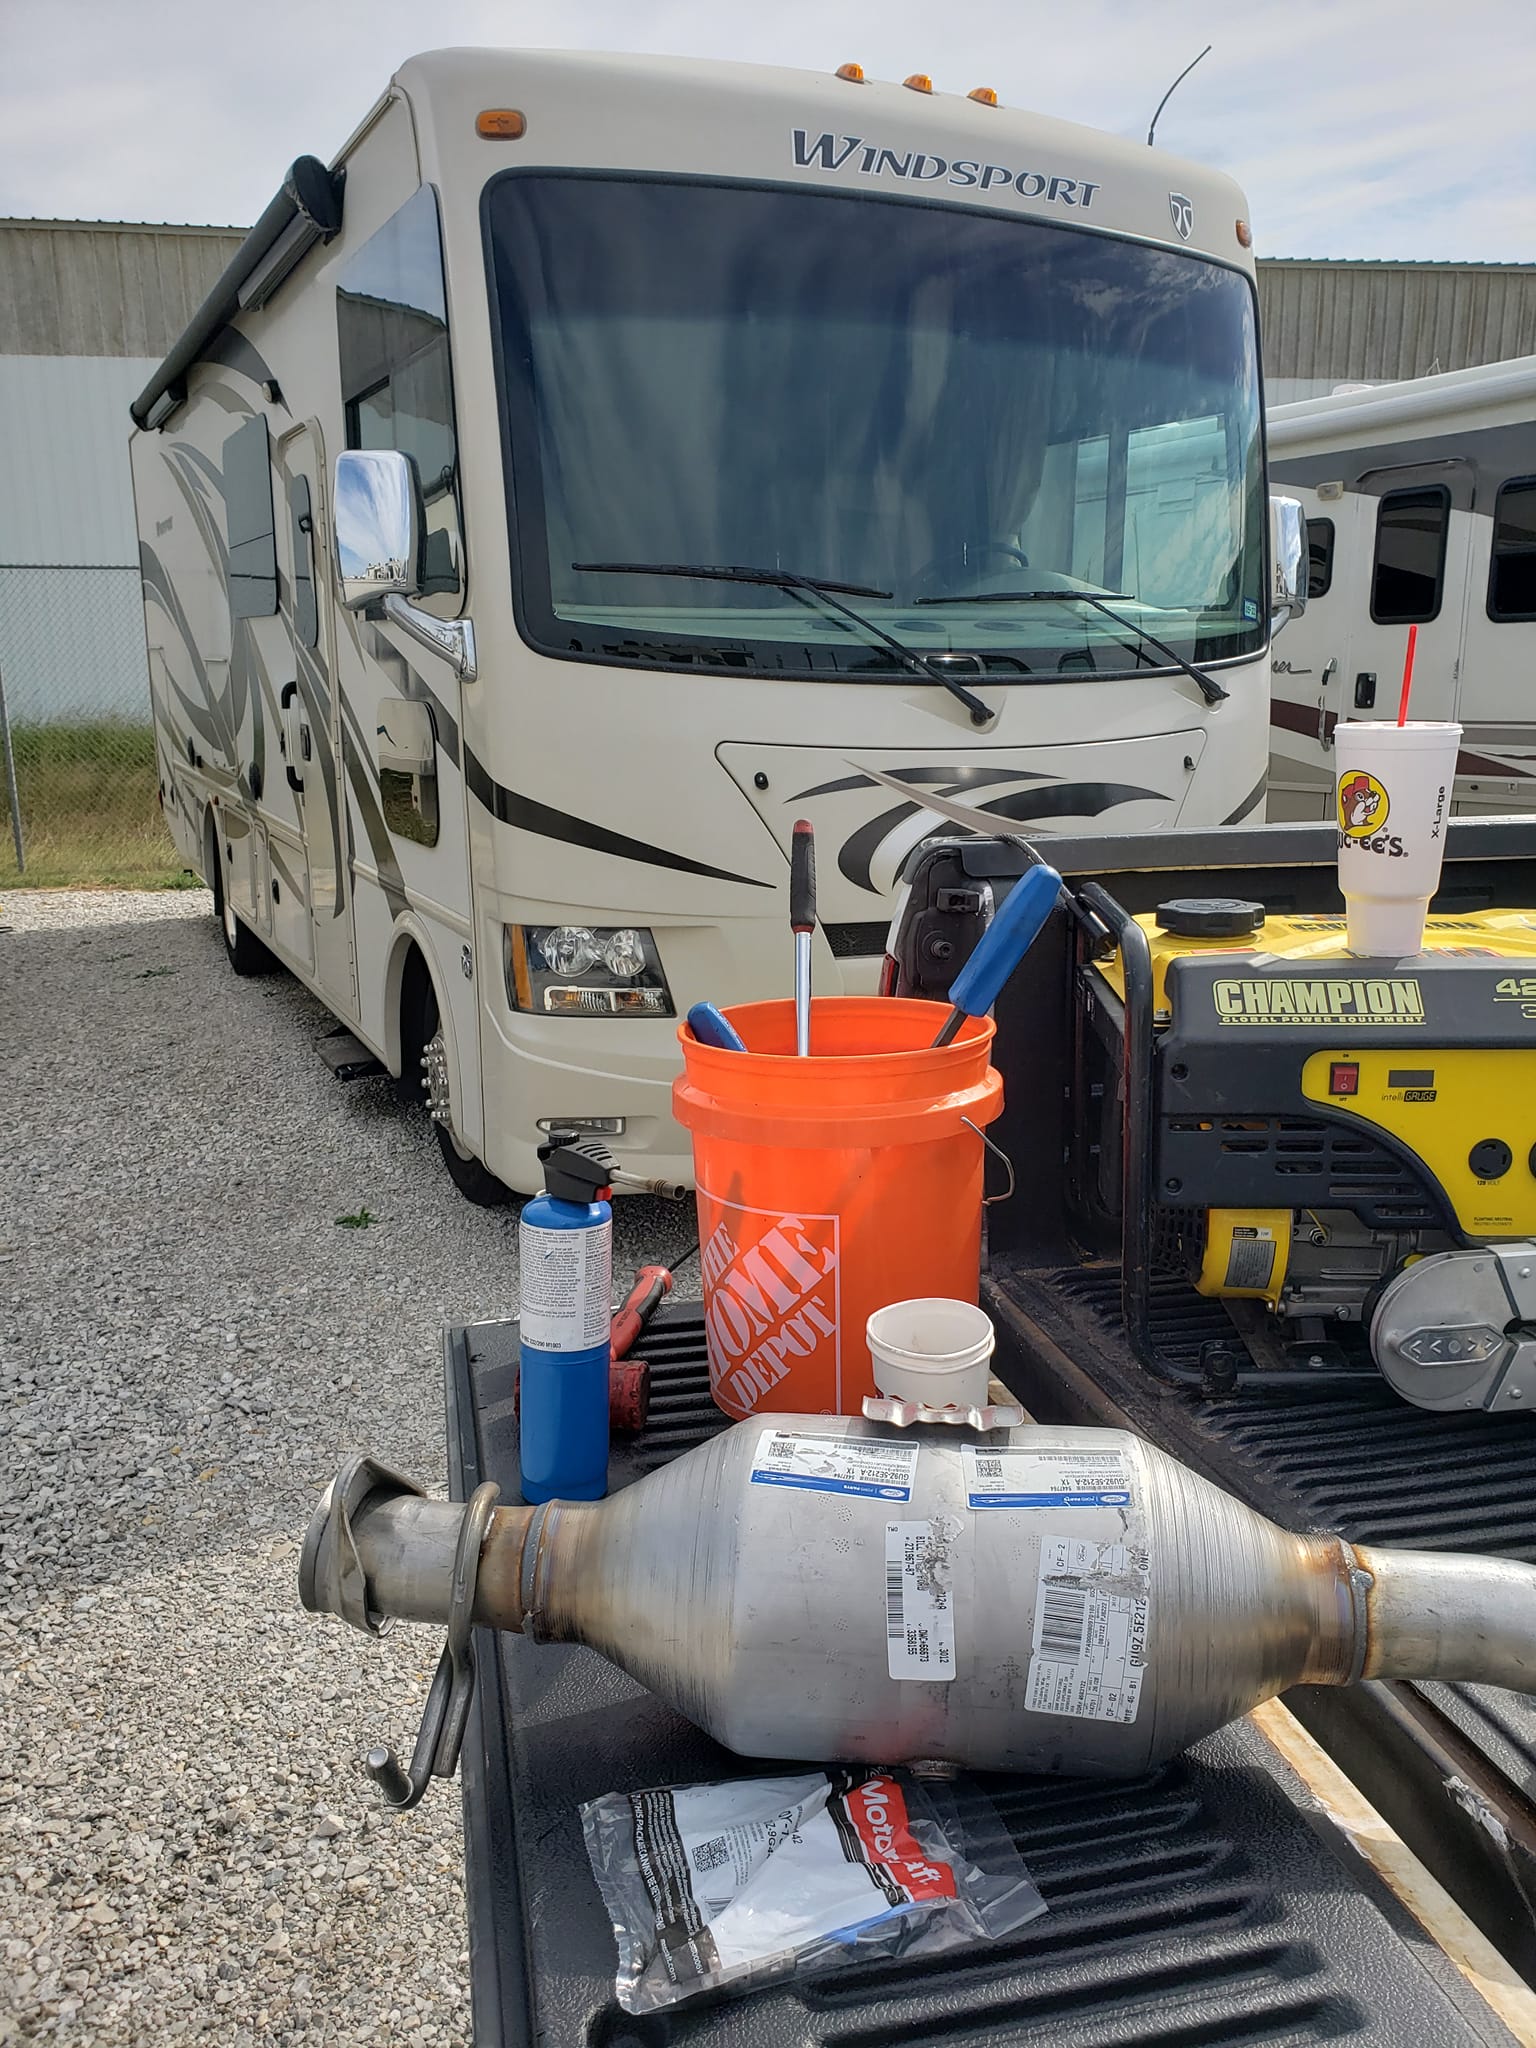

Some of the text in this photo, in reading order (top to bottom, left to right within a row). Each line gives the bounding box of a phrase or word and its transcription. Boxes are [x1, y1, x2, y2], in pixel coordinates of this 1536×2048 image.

[1430, 786, 1445, 839] X-Large
[1215, 981, 1417, 1015] CHAMPION
[1222, 1016, 1425, 1024] GLOBAL POWER EQUIPMENT
[702, 1221, 740, 1292] THE
[705, 1214, 836, 1389] HOME
[729, 1295, 837, 1410] DEPOT
[1056, 1543, 1065, 1567] CF-2
[1105, 1692, 1118, 1717] CF-02
[860, 1780, 942, 1885] Motoraft
